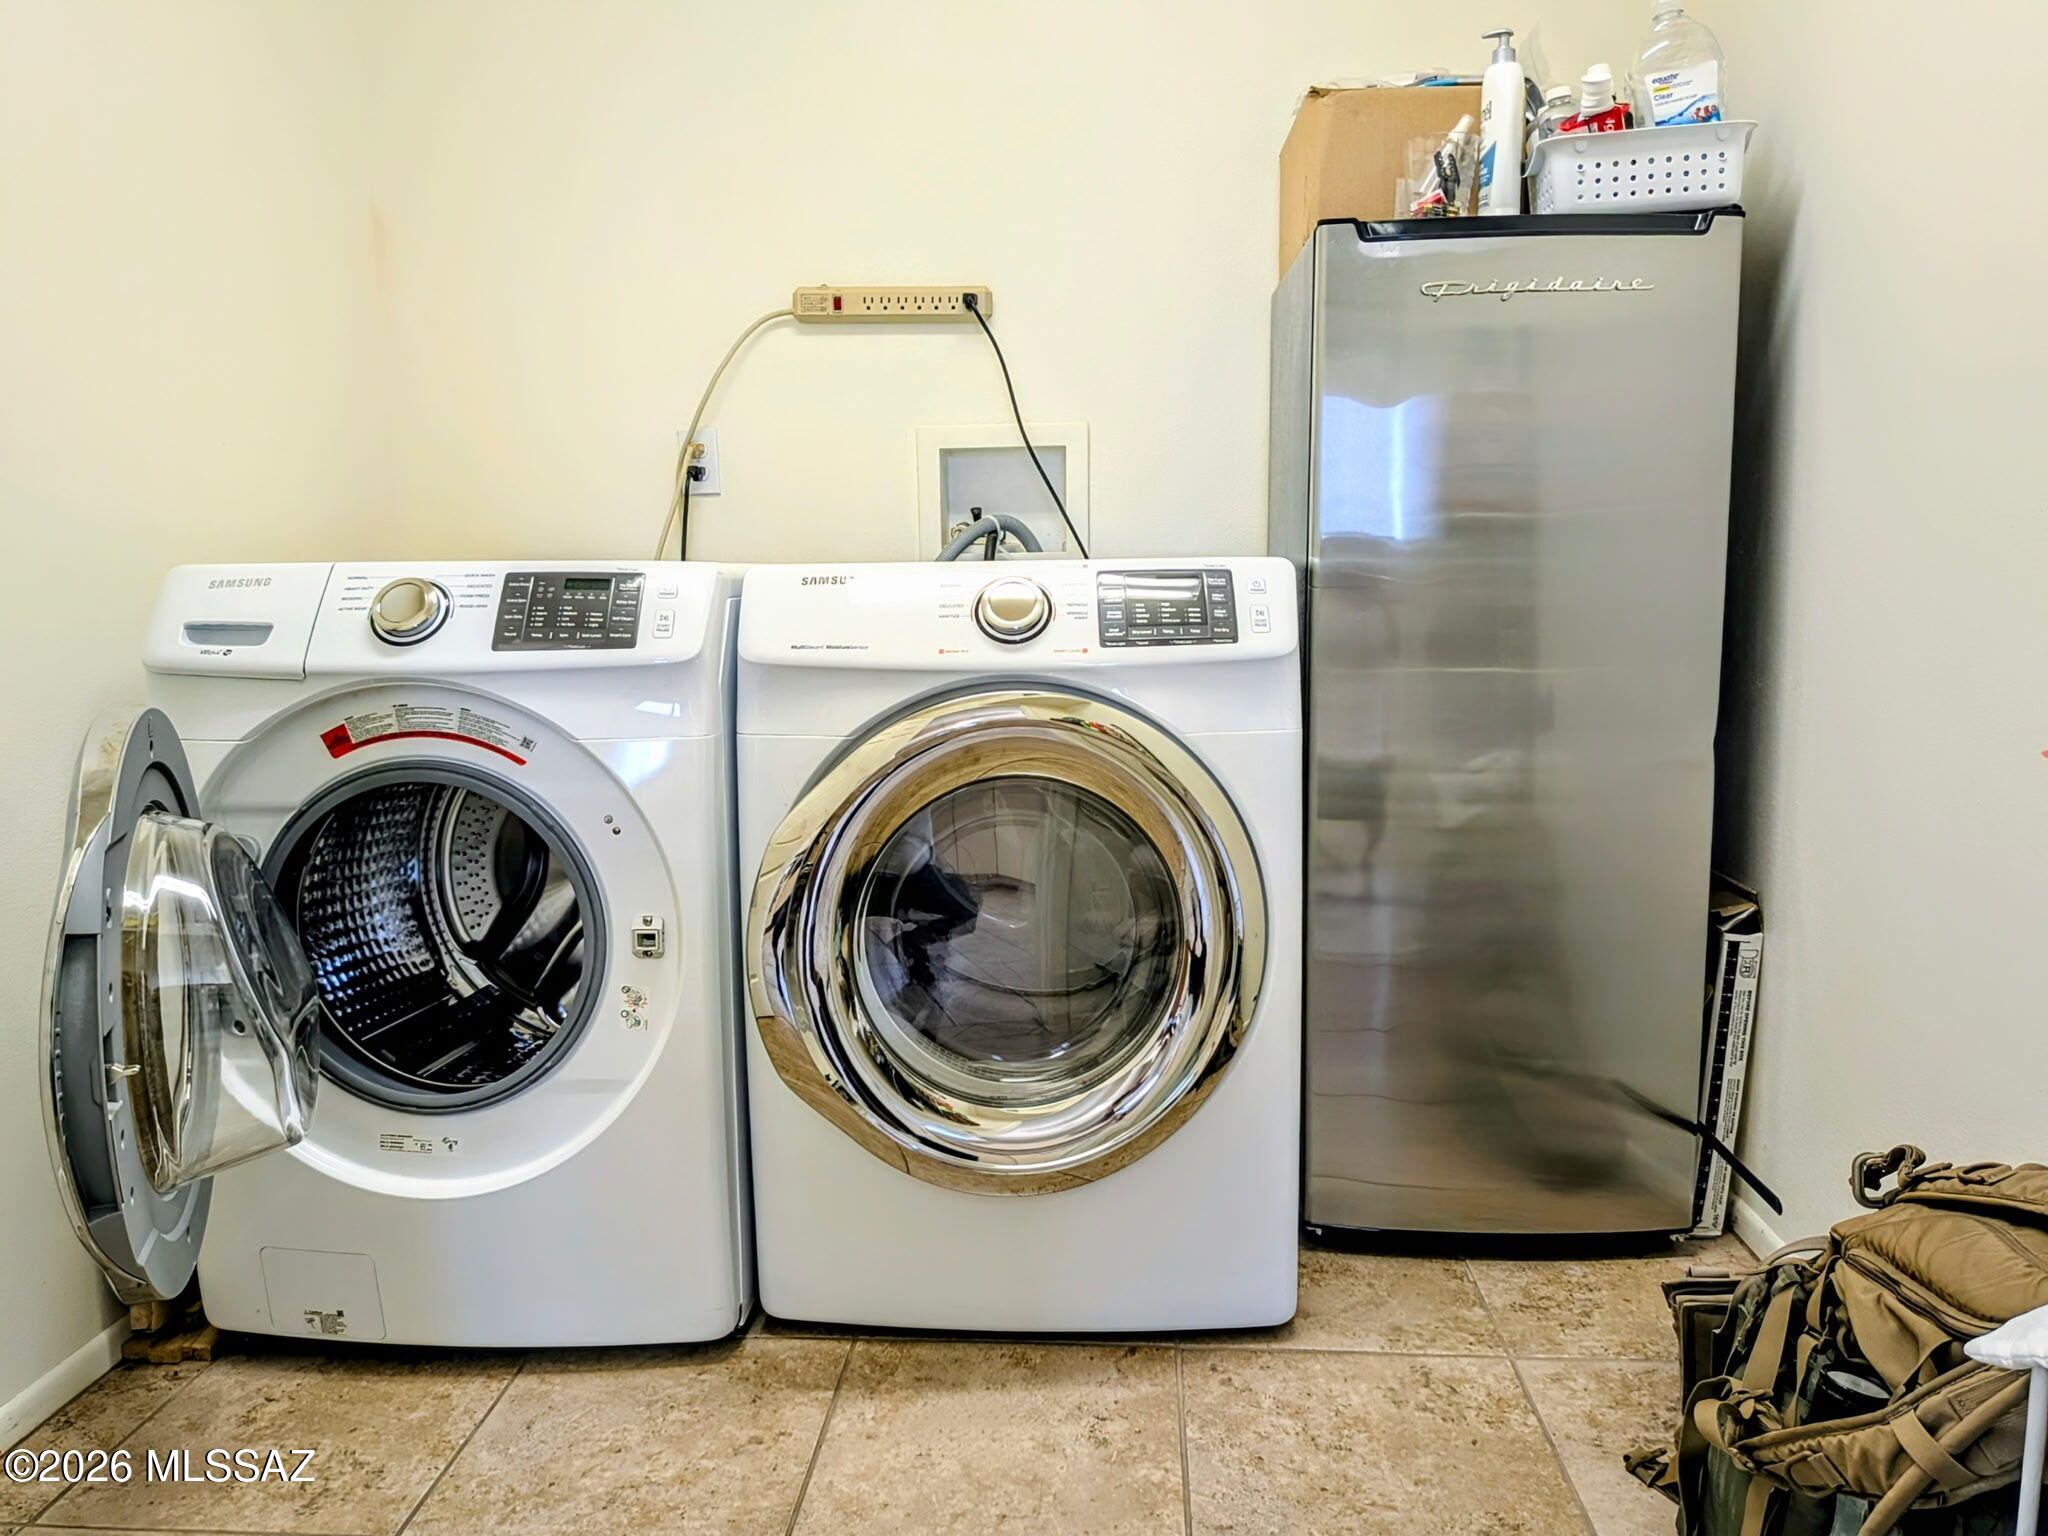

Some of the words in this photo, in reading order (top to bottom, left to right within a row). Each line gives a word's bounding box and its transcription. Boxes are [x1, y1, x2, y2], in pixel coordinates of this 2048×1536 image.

[1653, 93, 1673, 101] Clear
[1420, 276, 1655, 302] Frigidaire
[208, 577, 272, 589] SAMSUNG
